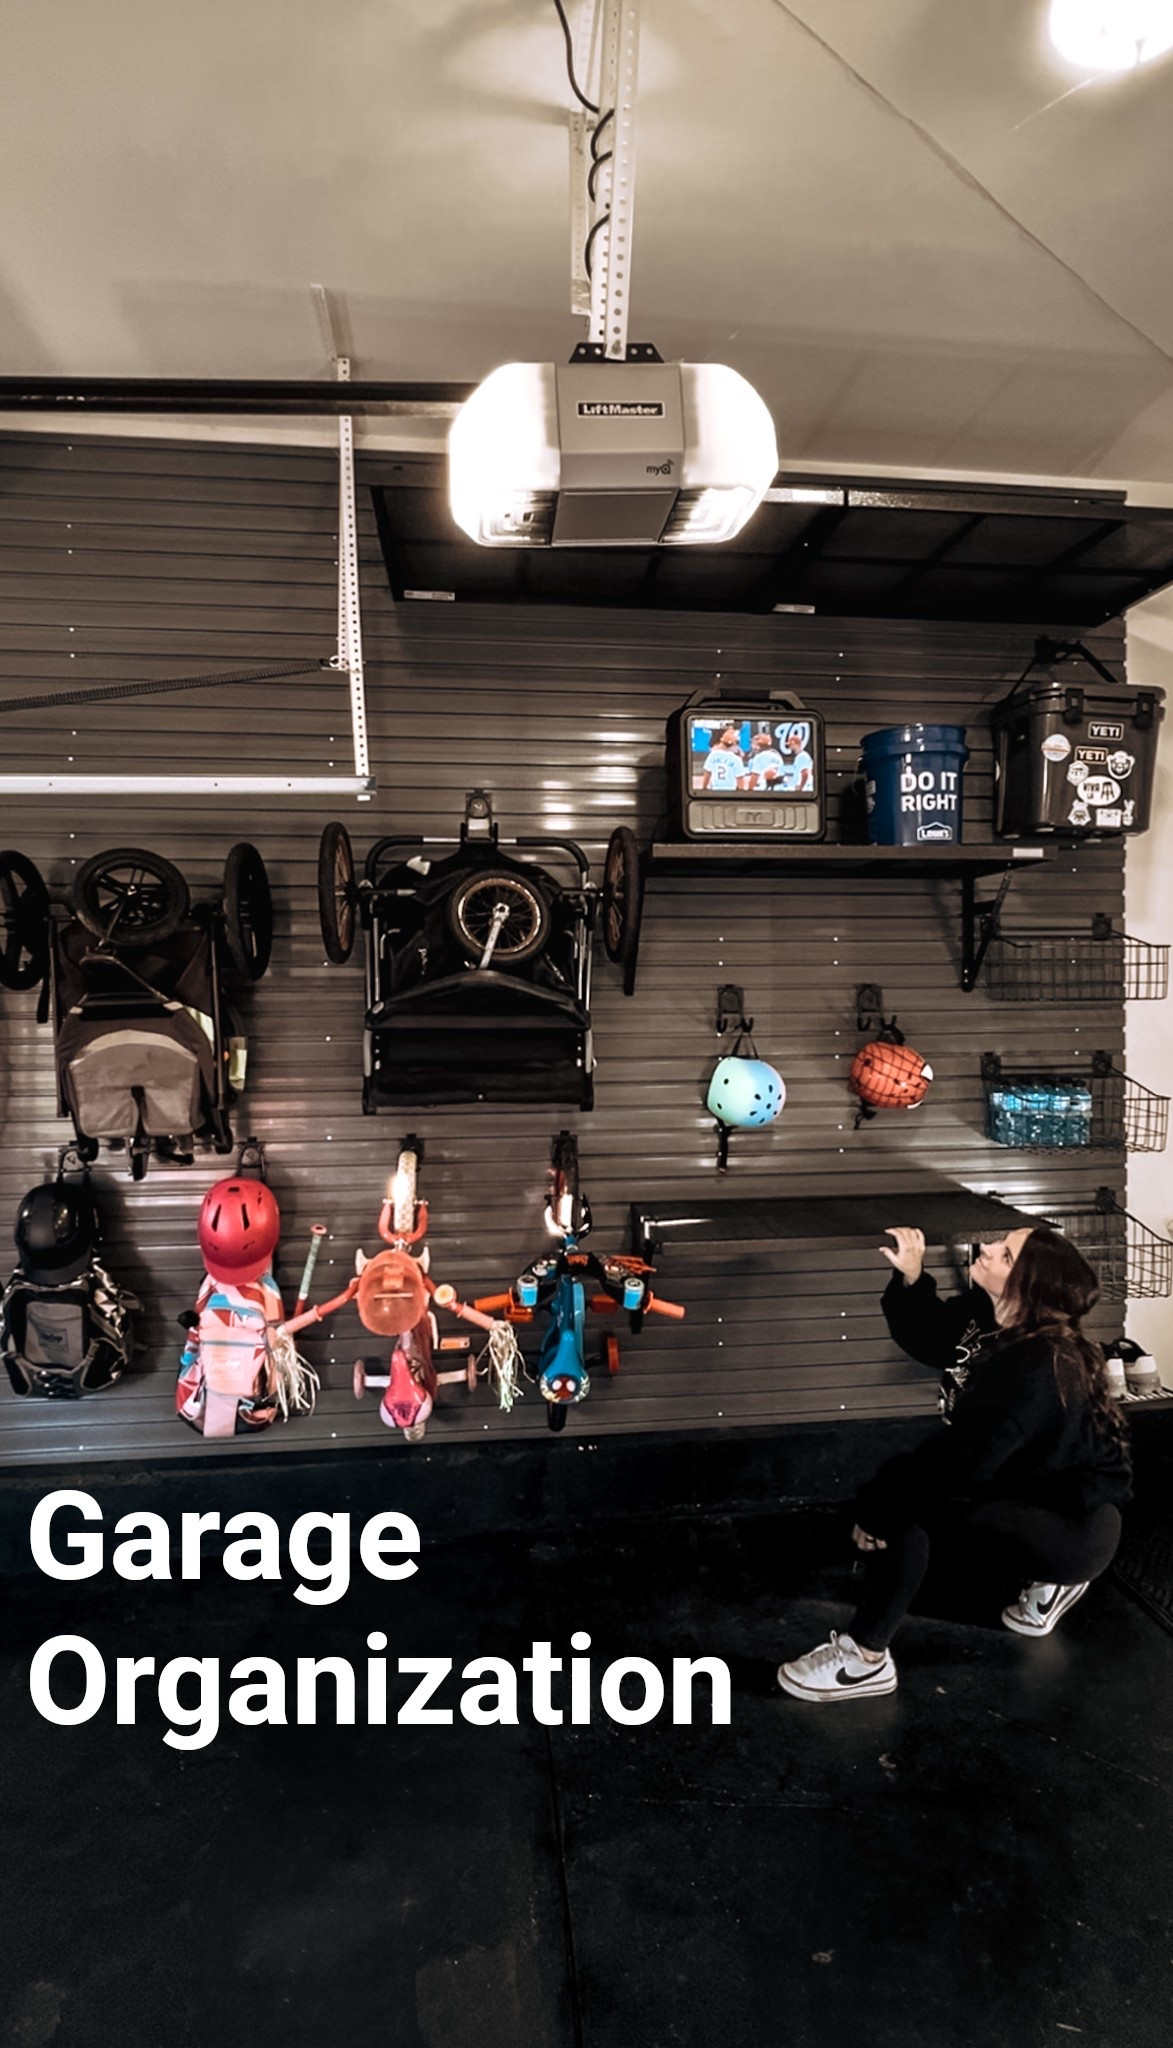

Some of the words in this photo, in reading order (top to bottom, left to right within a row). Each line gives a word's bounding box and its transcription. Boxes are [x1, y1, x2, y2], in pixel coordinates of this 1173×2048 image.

[583, 404, 658, 414] LiftMaster
[646, 463, 671, 476] myQ
[1092, 726, 1120, 737] YETI
[1079, 750, 1105, 760] YETI
[717, 766, 726, 780] 2
[900, 771, 935, 792] DO
[941, 771, 958, 791] IT
[901, 793, 958, 812] RIGHT
